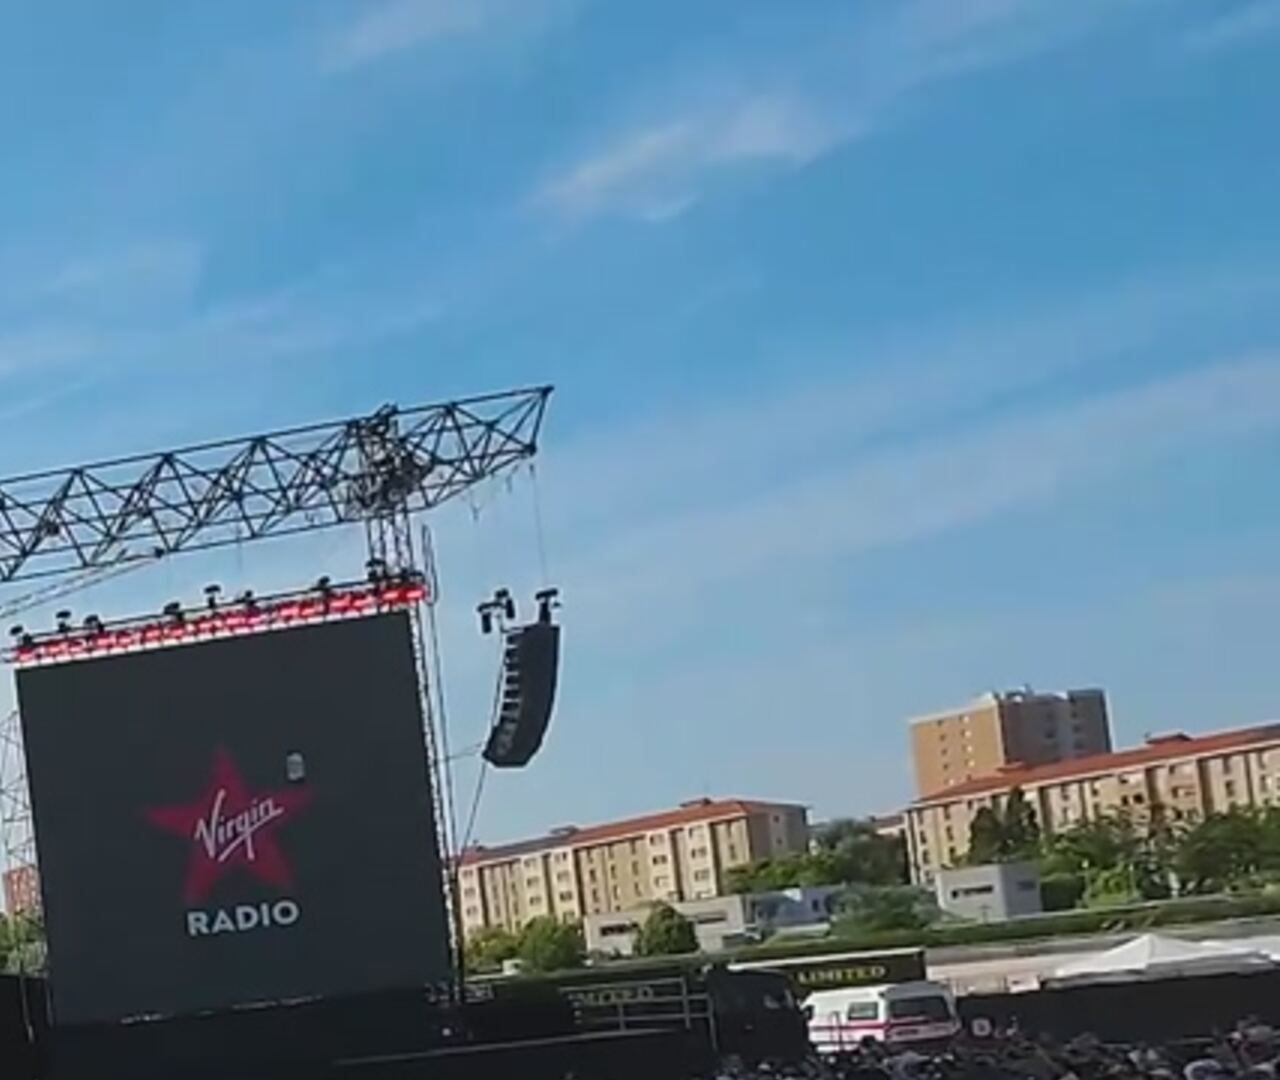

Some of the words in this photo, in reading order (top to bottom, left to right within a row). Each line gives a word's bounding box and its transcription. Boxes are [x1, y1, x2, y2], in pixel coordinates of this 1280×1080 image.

[194, 788, 285, 863] Virgin
[187, 900, 300, 937] RADIO
[798, 965, 886, 984] LIMITED
